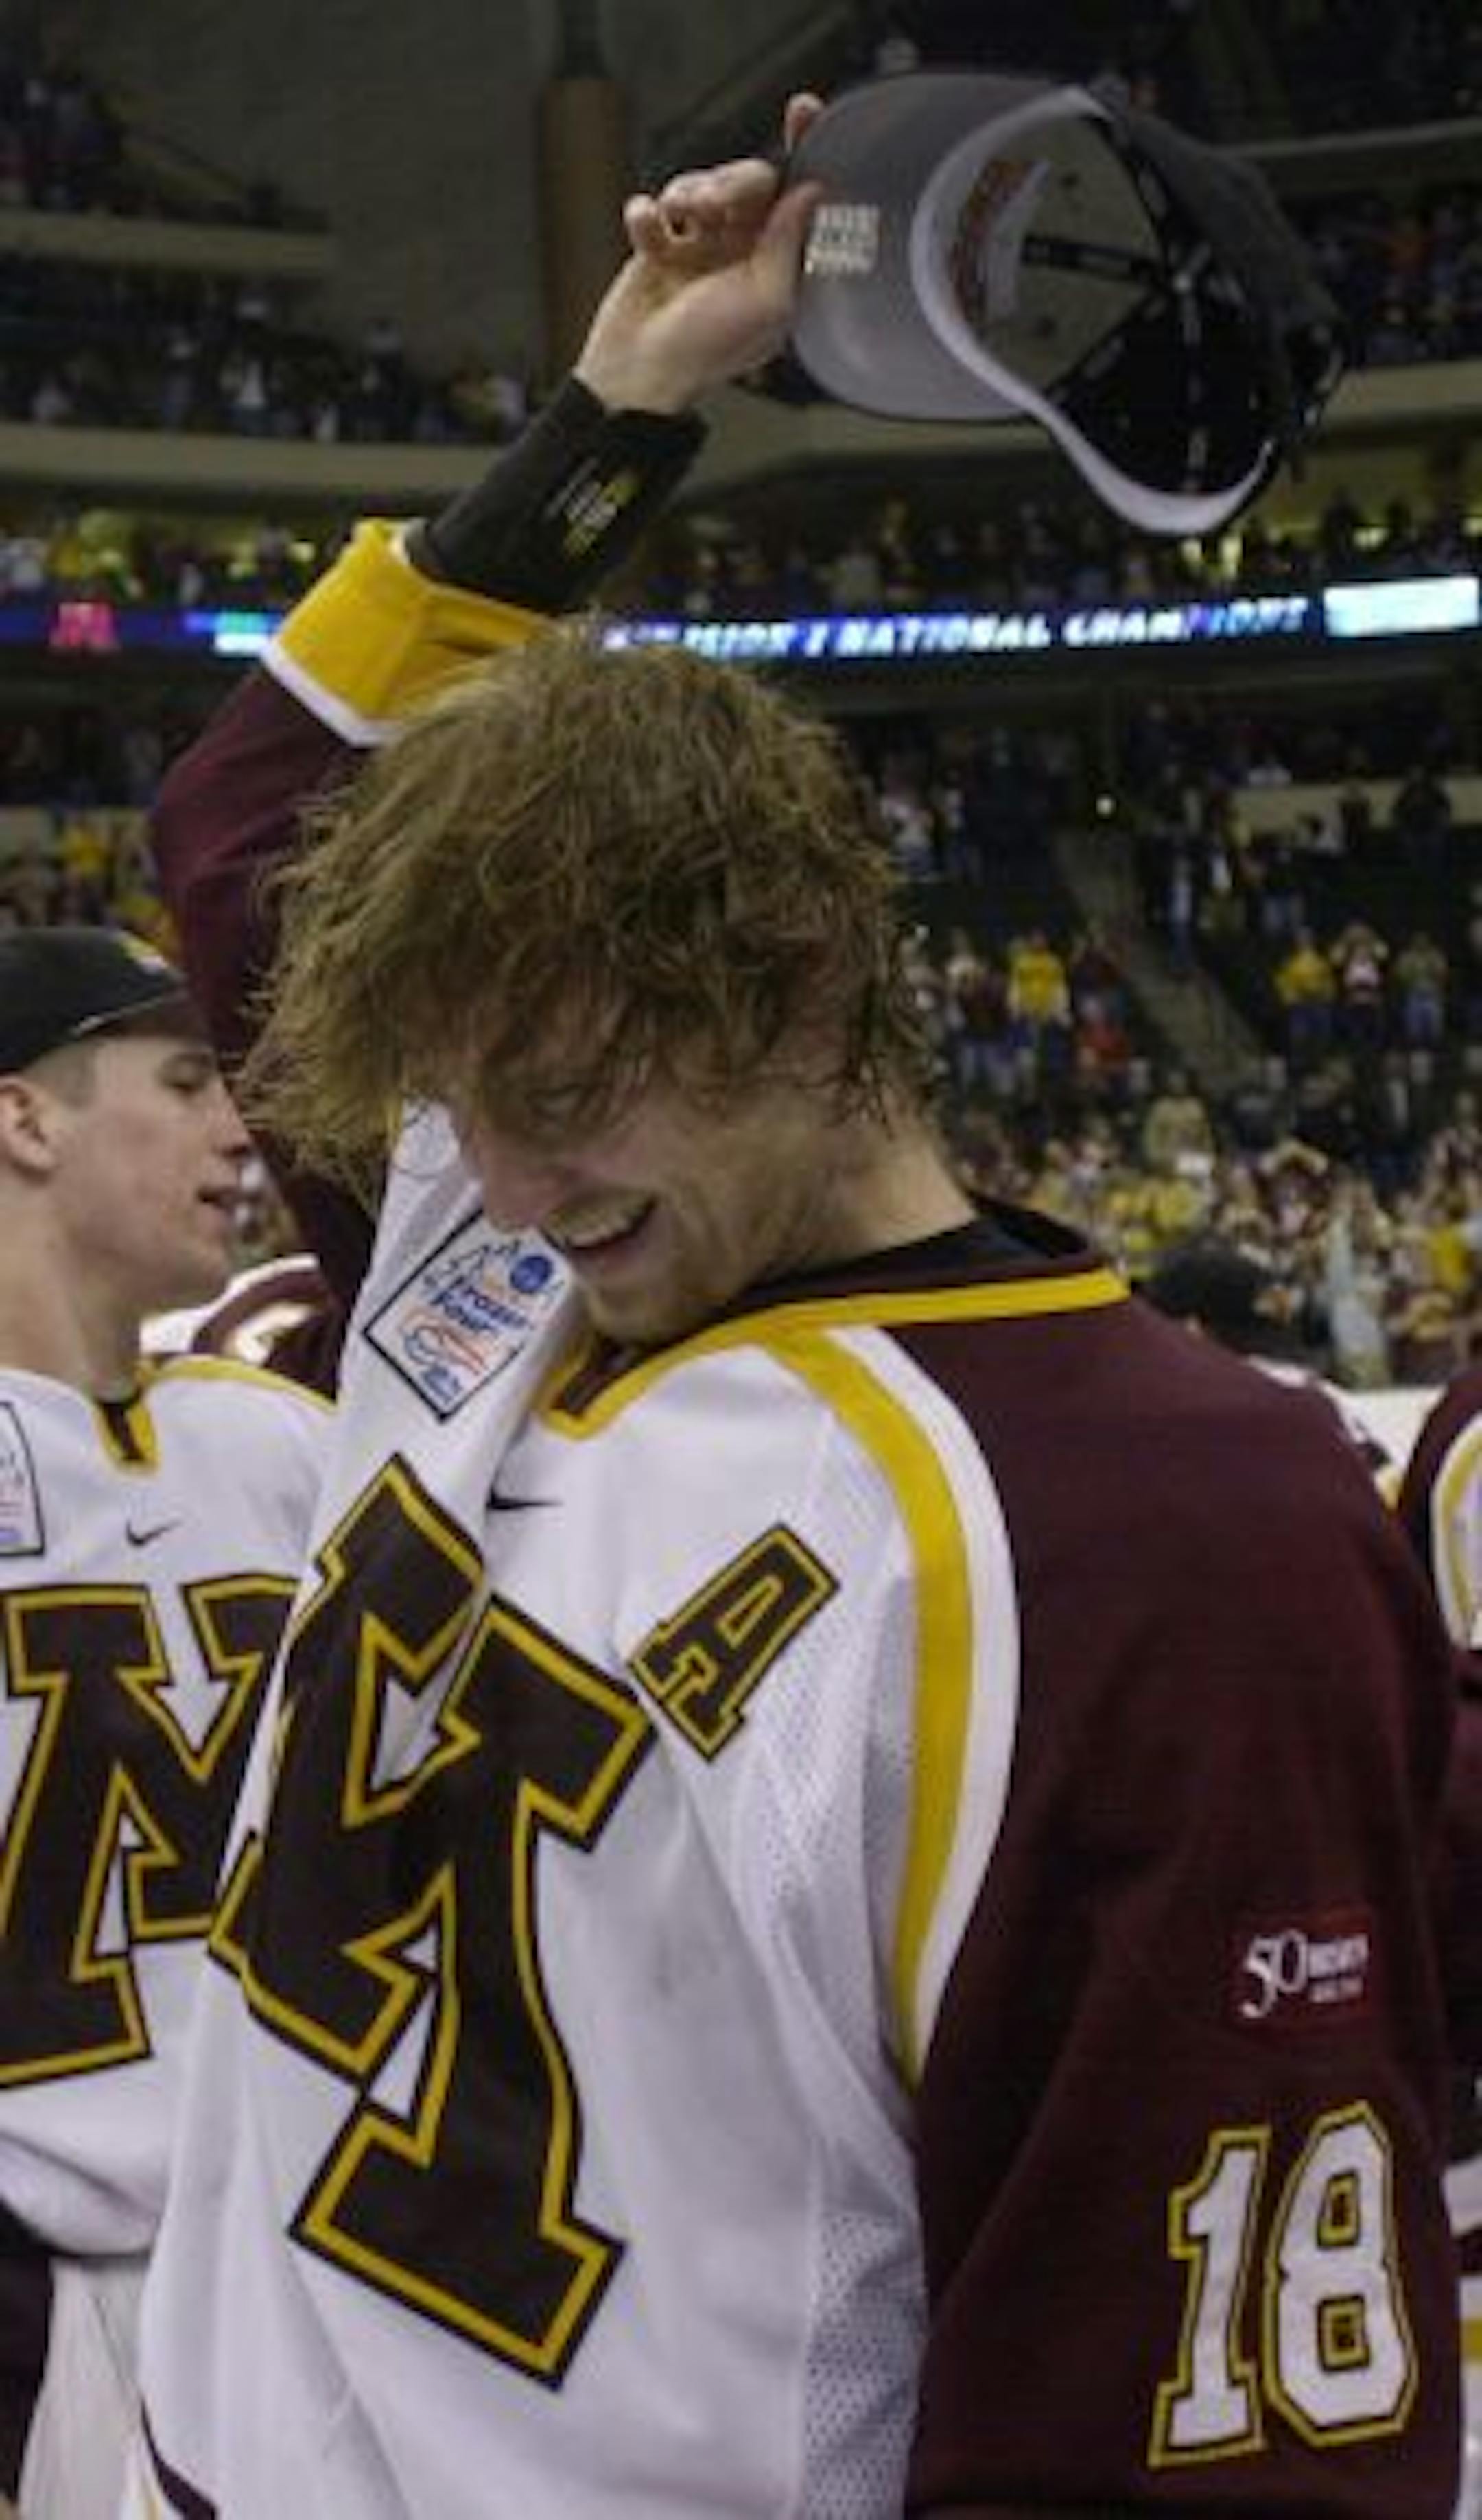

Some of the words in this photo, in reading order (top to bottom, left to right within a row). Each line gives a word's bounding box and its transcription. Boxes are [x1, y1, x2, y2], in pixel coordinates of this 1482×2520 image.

[834, 615, 1052, 657] NATIONAL
[1063, 596, 1308, 647] CHAMPIONS
[628, 1522, 841, 1763] A
[207, 1451, 659, 2391] M
[1238, 1929, 1308, 2018] 50
[1148, 2099, 1419, 2470] 18
